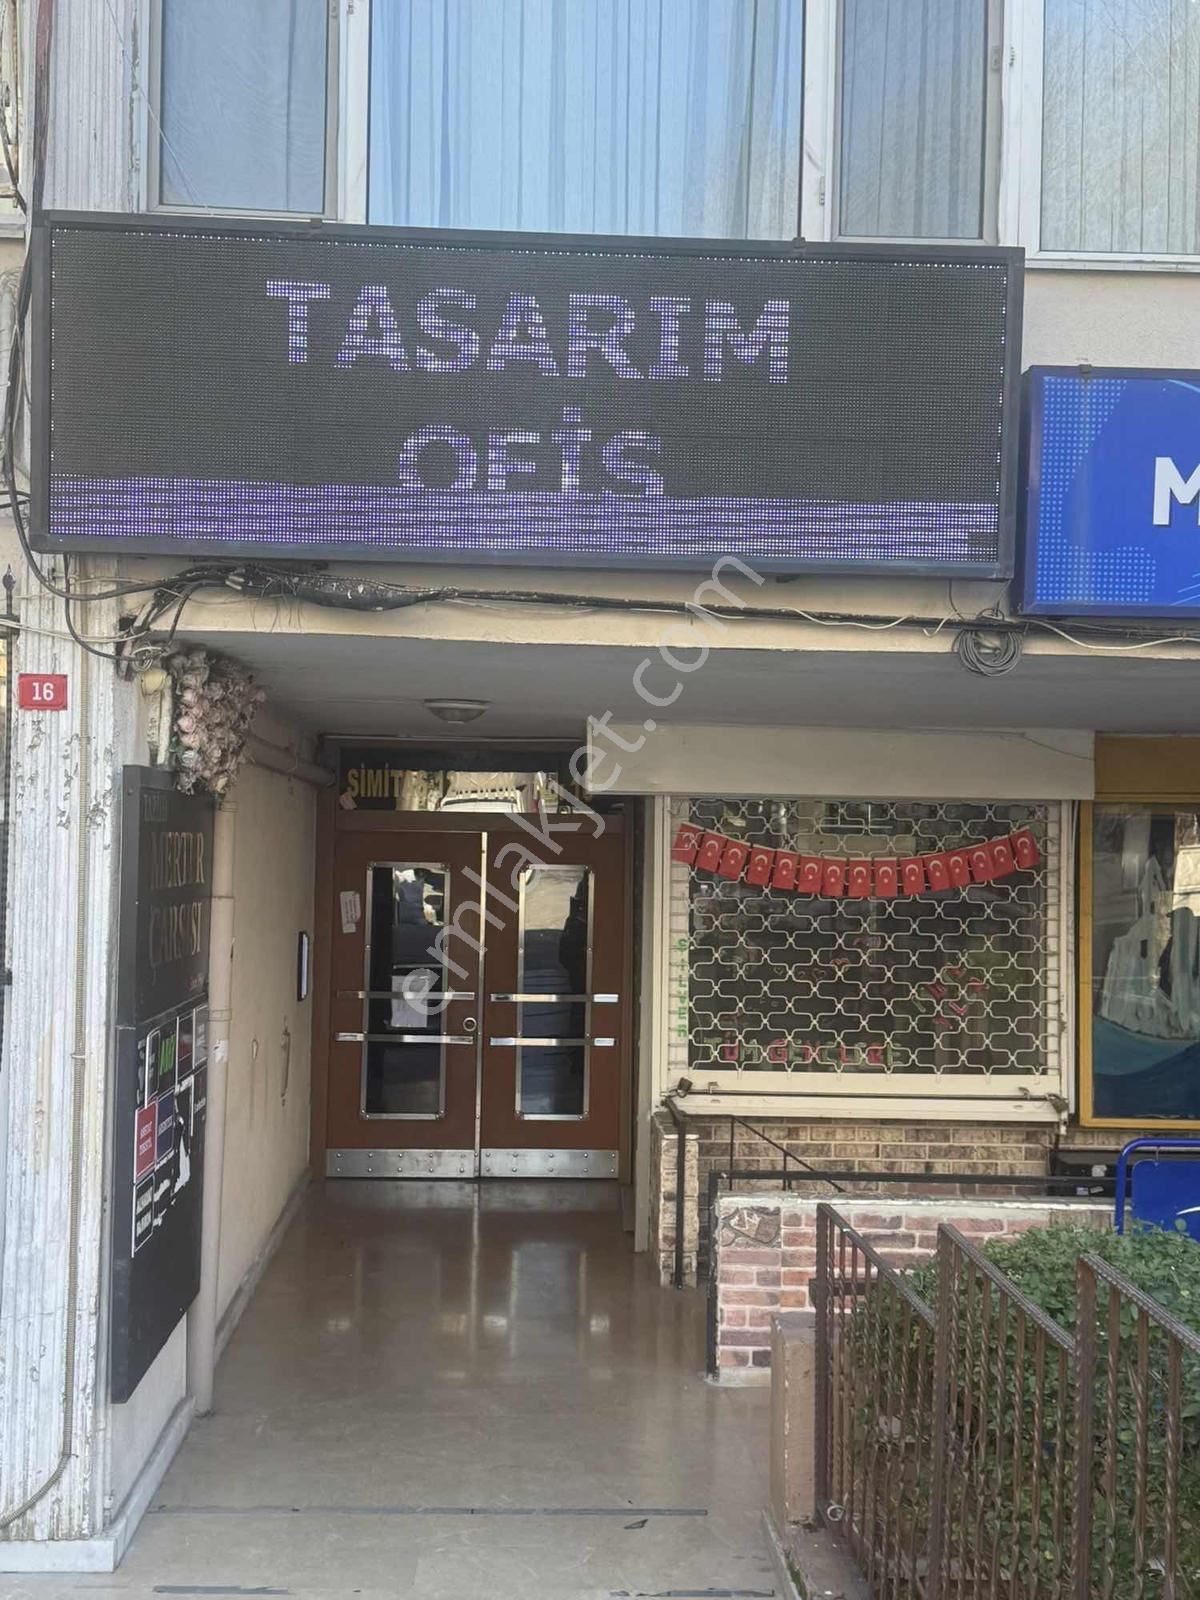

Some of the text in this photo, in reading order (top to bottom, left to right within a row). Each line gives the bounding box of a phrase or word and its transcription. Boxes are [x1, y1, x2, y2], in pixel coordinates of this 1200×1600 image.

[266, 280, 790, 384] TASARIM
[399, 406, 665, 497] OFİS
[1152, 456, 1200, 526] M
[32, 682, 54, 701] 16
